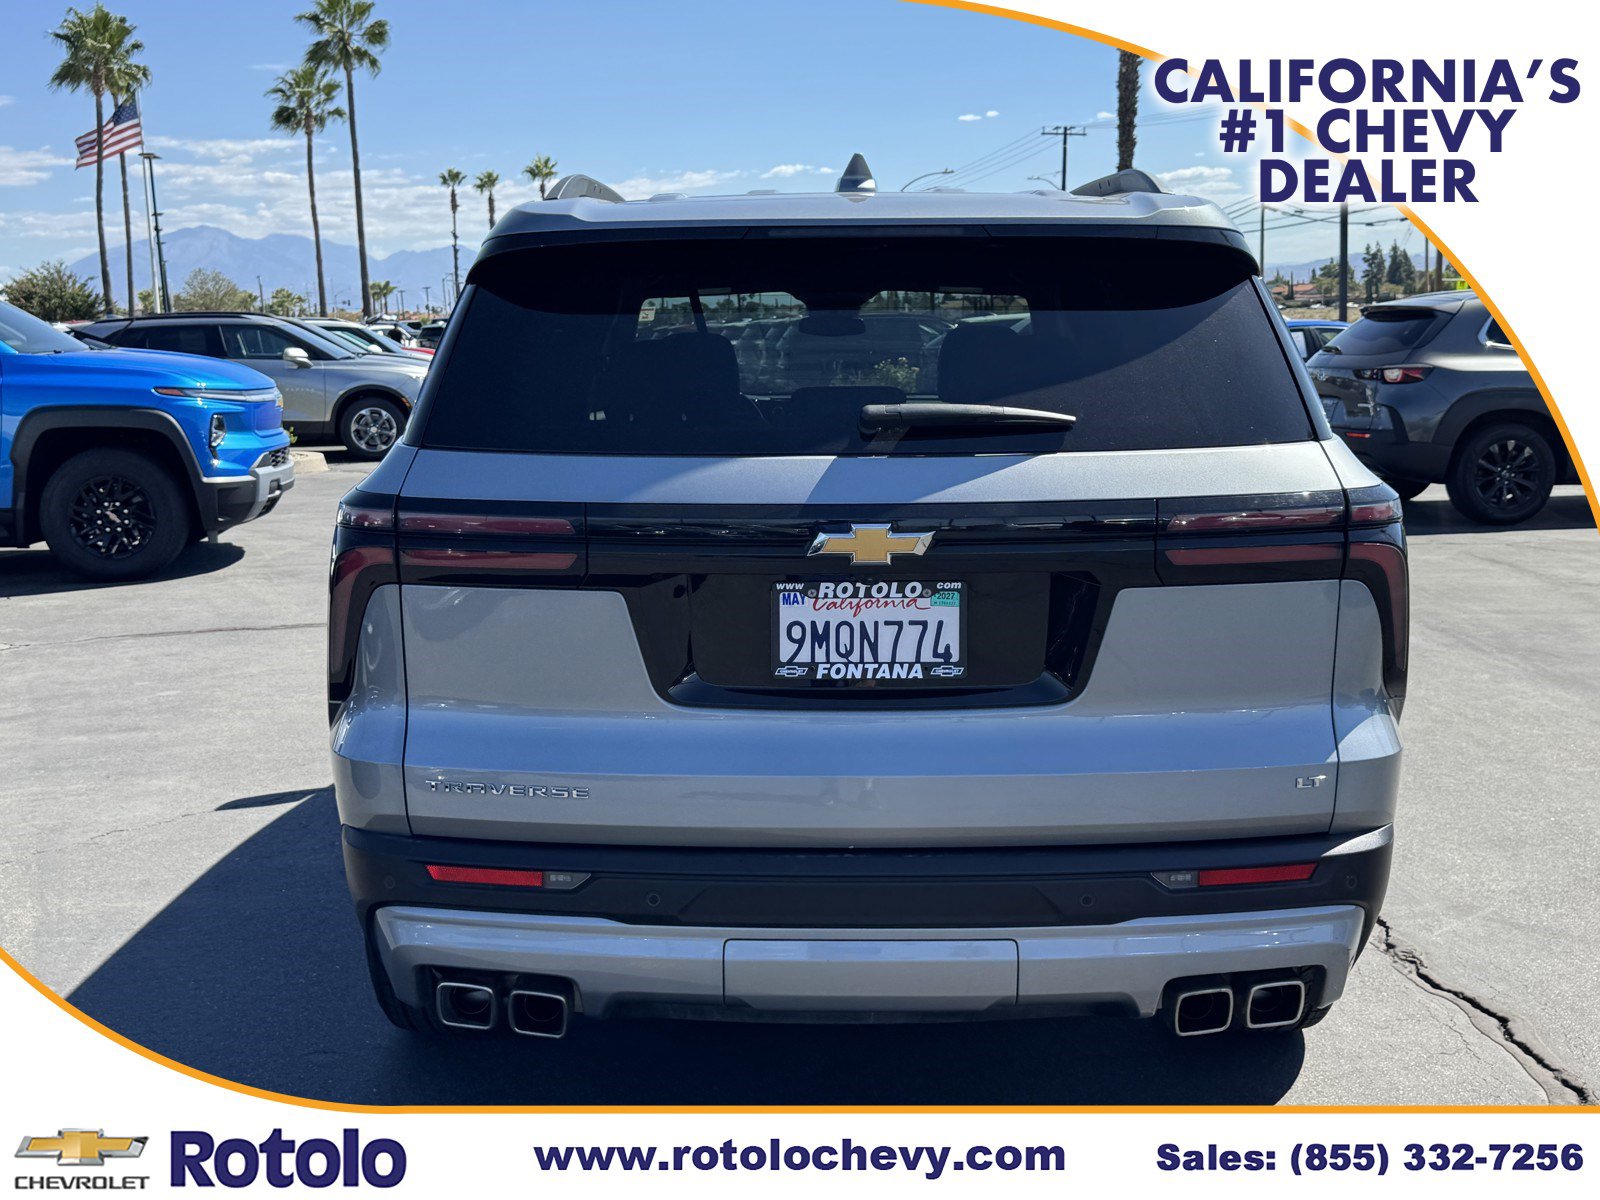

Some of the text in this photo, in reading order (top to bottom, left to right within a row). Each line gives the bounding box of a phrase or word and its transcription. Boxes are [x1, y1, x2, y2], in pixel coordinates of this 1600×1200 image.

[818, 582, 923, 598] ROTOLO
[936, 581, 962, 589] com
[936, 592, 955, 600] 2027
[782, 593, 807, 606] MAY
[812, 598, 931, 618] California
[786, 620, 953, 663] 9MQN774
[816, 663, 924, 679] FONTANA
[425, 780, 590, 799] TRAVERSE
[1295, 775, 1327, 789] LT
